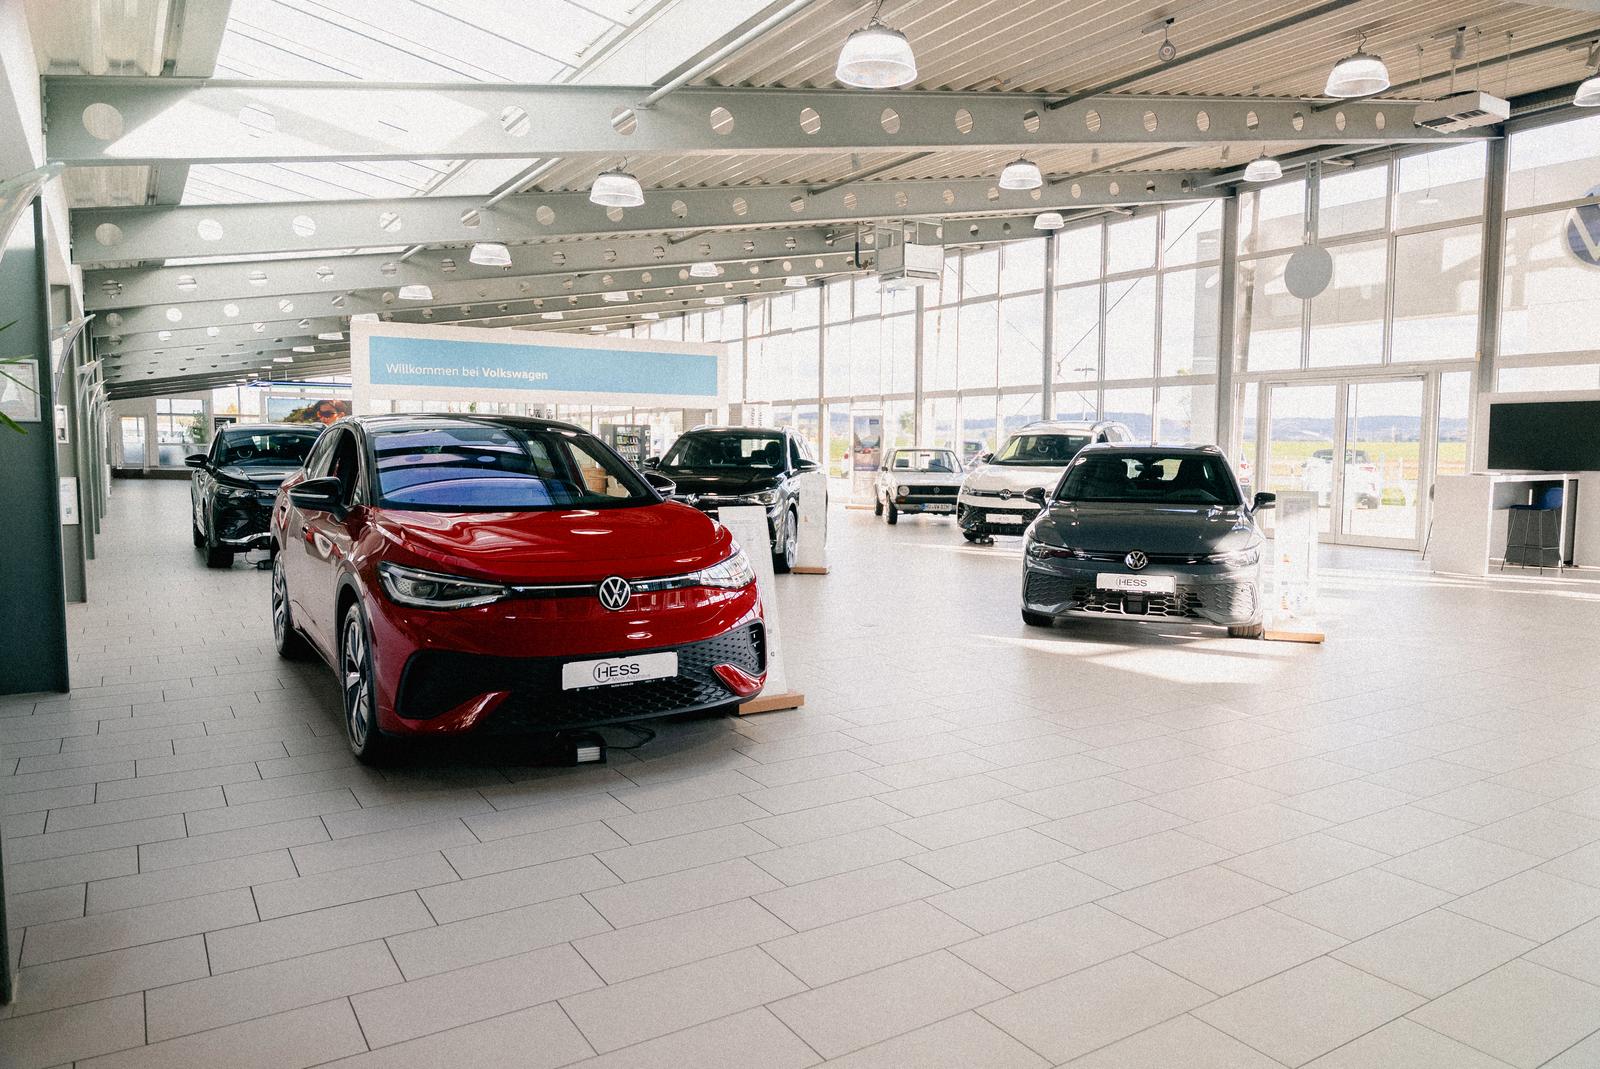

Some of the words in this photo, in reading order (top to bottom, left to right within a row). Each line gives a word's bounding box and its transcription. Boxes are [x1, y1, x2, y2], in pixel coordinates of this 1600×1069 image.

[386, 363, 459, 376] Willkommen
[462, 366, 479, 377] bei
[482, 367, 549, 382] Volkswagen
[1119, 579, 1148, 587] HESS
[597, 663, 640, 679] HESS
